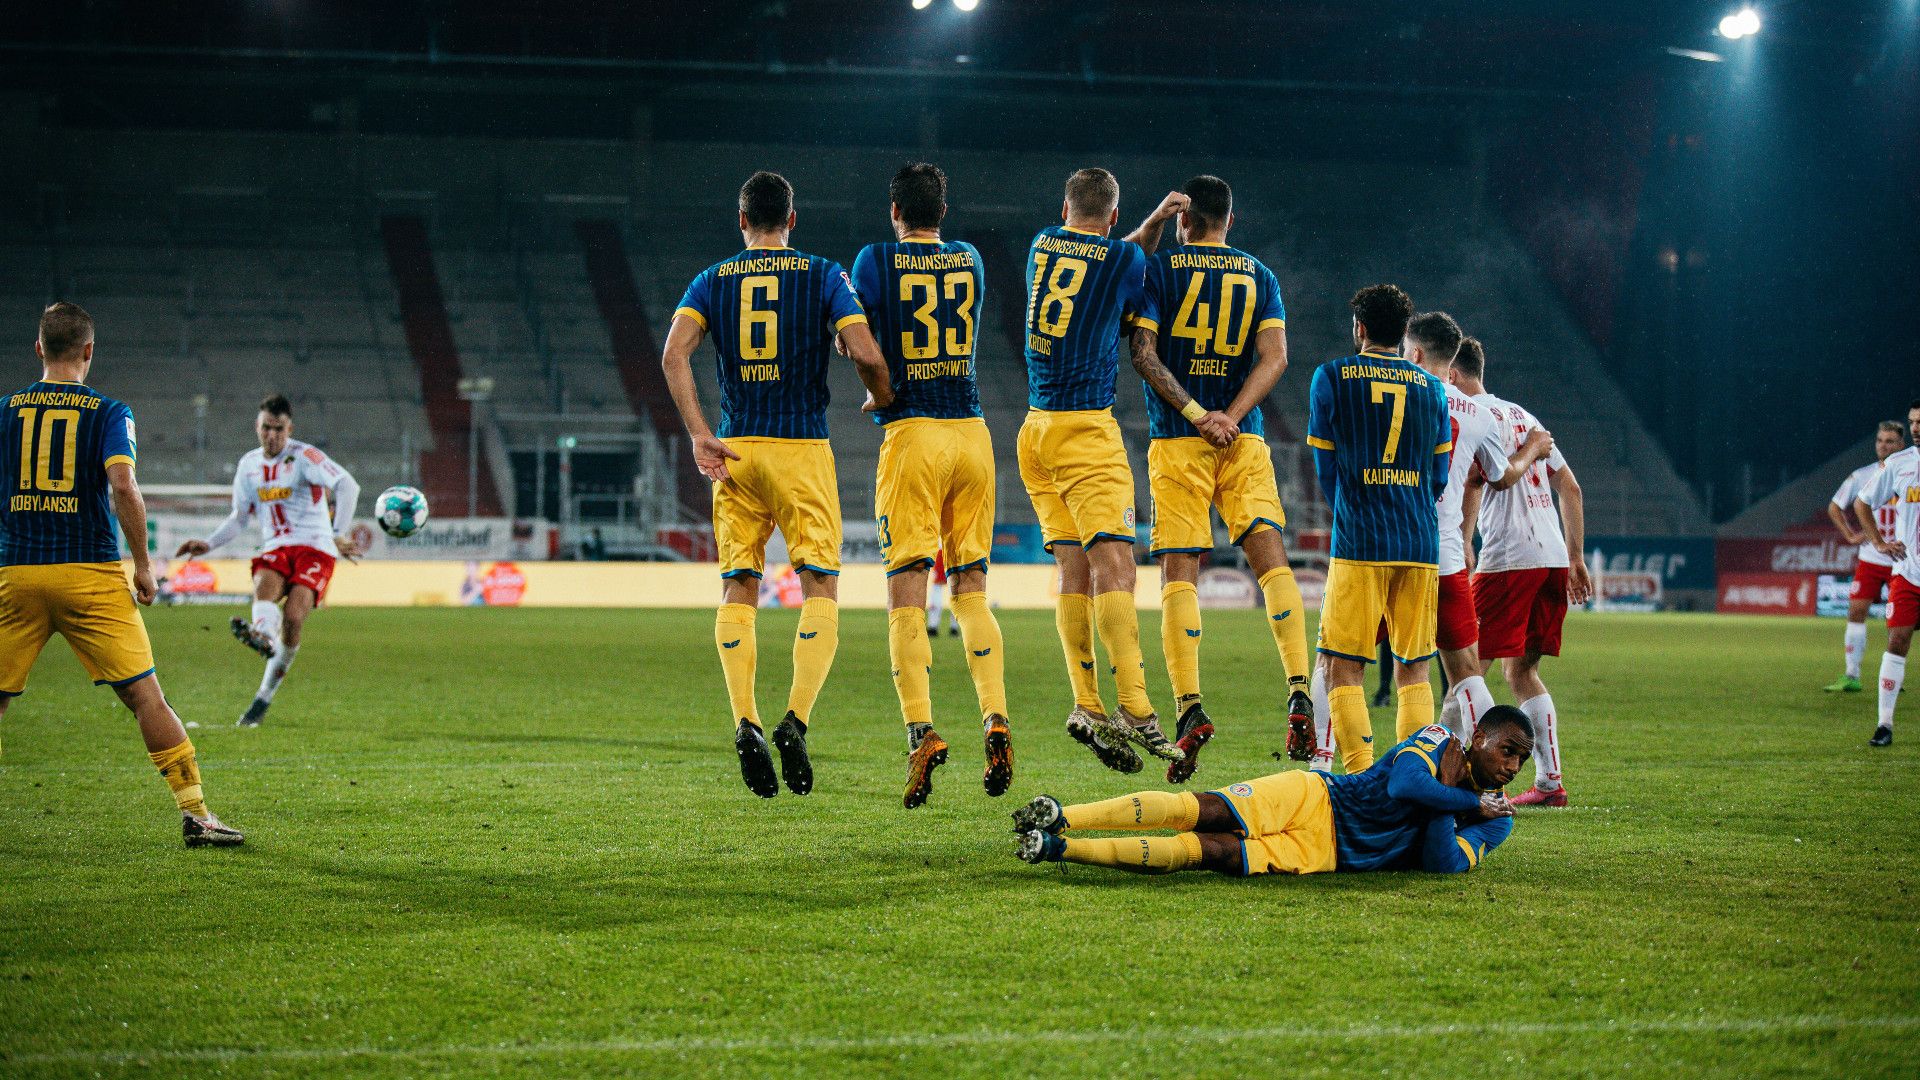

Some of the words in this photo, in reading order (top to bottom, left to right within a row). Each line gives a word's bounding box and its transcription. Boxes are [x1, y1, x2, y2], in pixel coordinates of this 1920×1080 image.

[718, 257, 810, 277] BRAUNSCHWEIG
[894, 251, 974, 270] BRAUNSCHWEIG
[1170, 254, 1256, 275] BRAUNSCHWEIG
[1028, 252, 1087, 338] 18
[739, 275, 779, 360] 6
[899, 271, 975, 360] 33
[1171, 271, 1257, 356] 40
[1028, 333, 1052, 356] KROOS
[740, 364, 781, 382] WYDRA
[906, 359, 970, 381] PROSCHWTZ
[1188, 359, 1229, 377] ZIEGELE
[1341, 365, 1428, 387] BRAUNSCHWEIG
[10, 391, 101, 411] BRAUNSCHWEIG
[1370, 381, 1407, 464] 7
[17, 408, 81, 492] 10
[1363, 468, 1420, 488] KAUFMANN
[10, 494, 79, 514] KOBYLANSKI
[876, 515, 893, 551] 3
